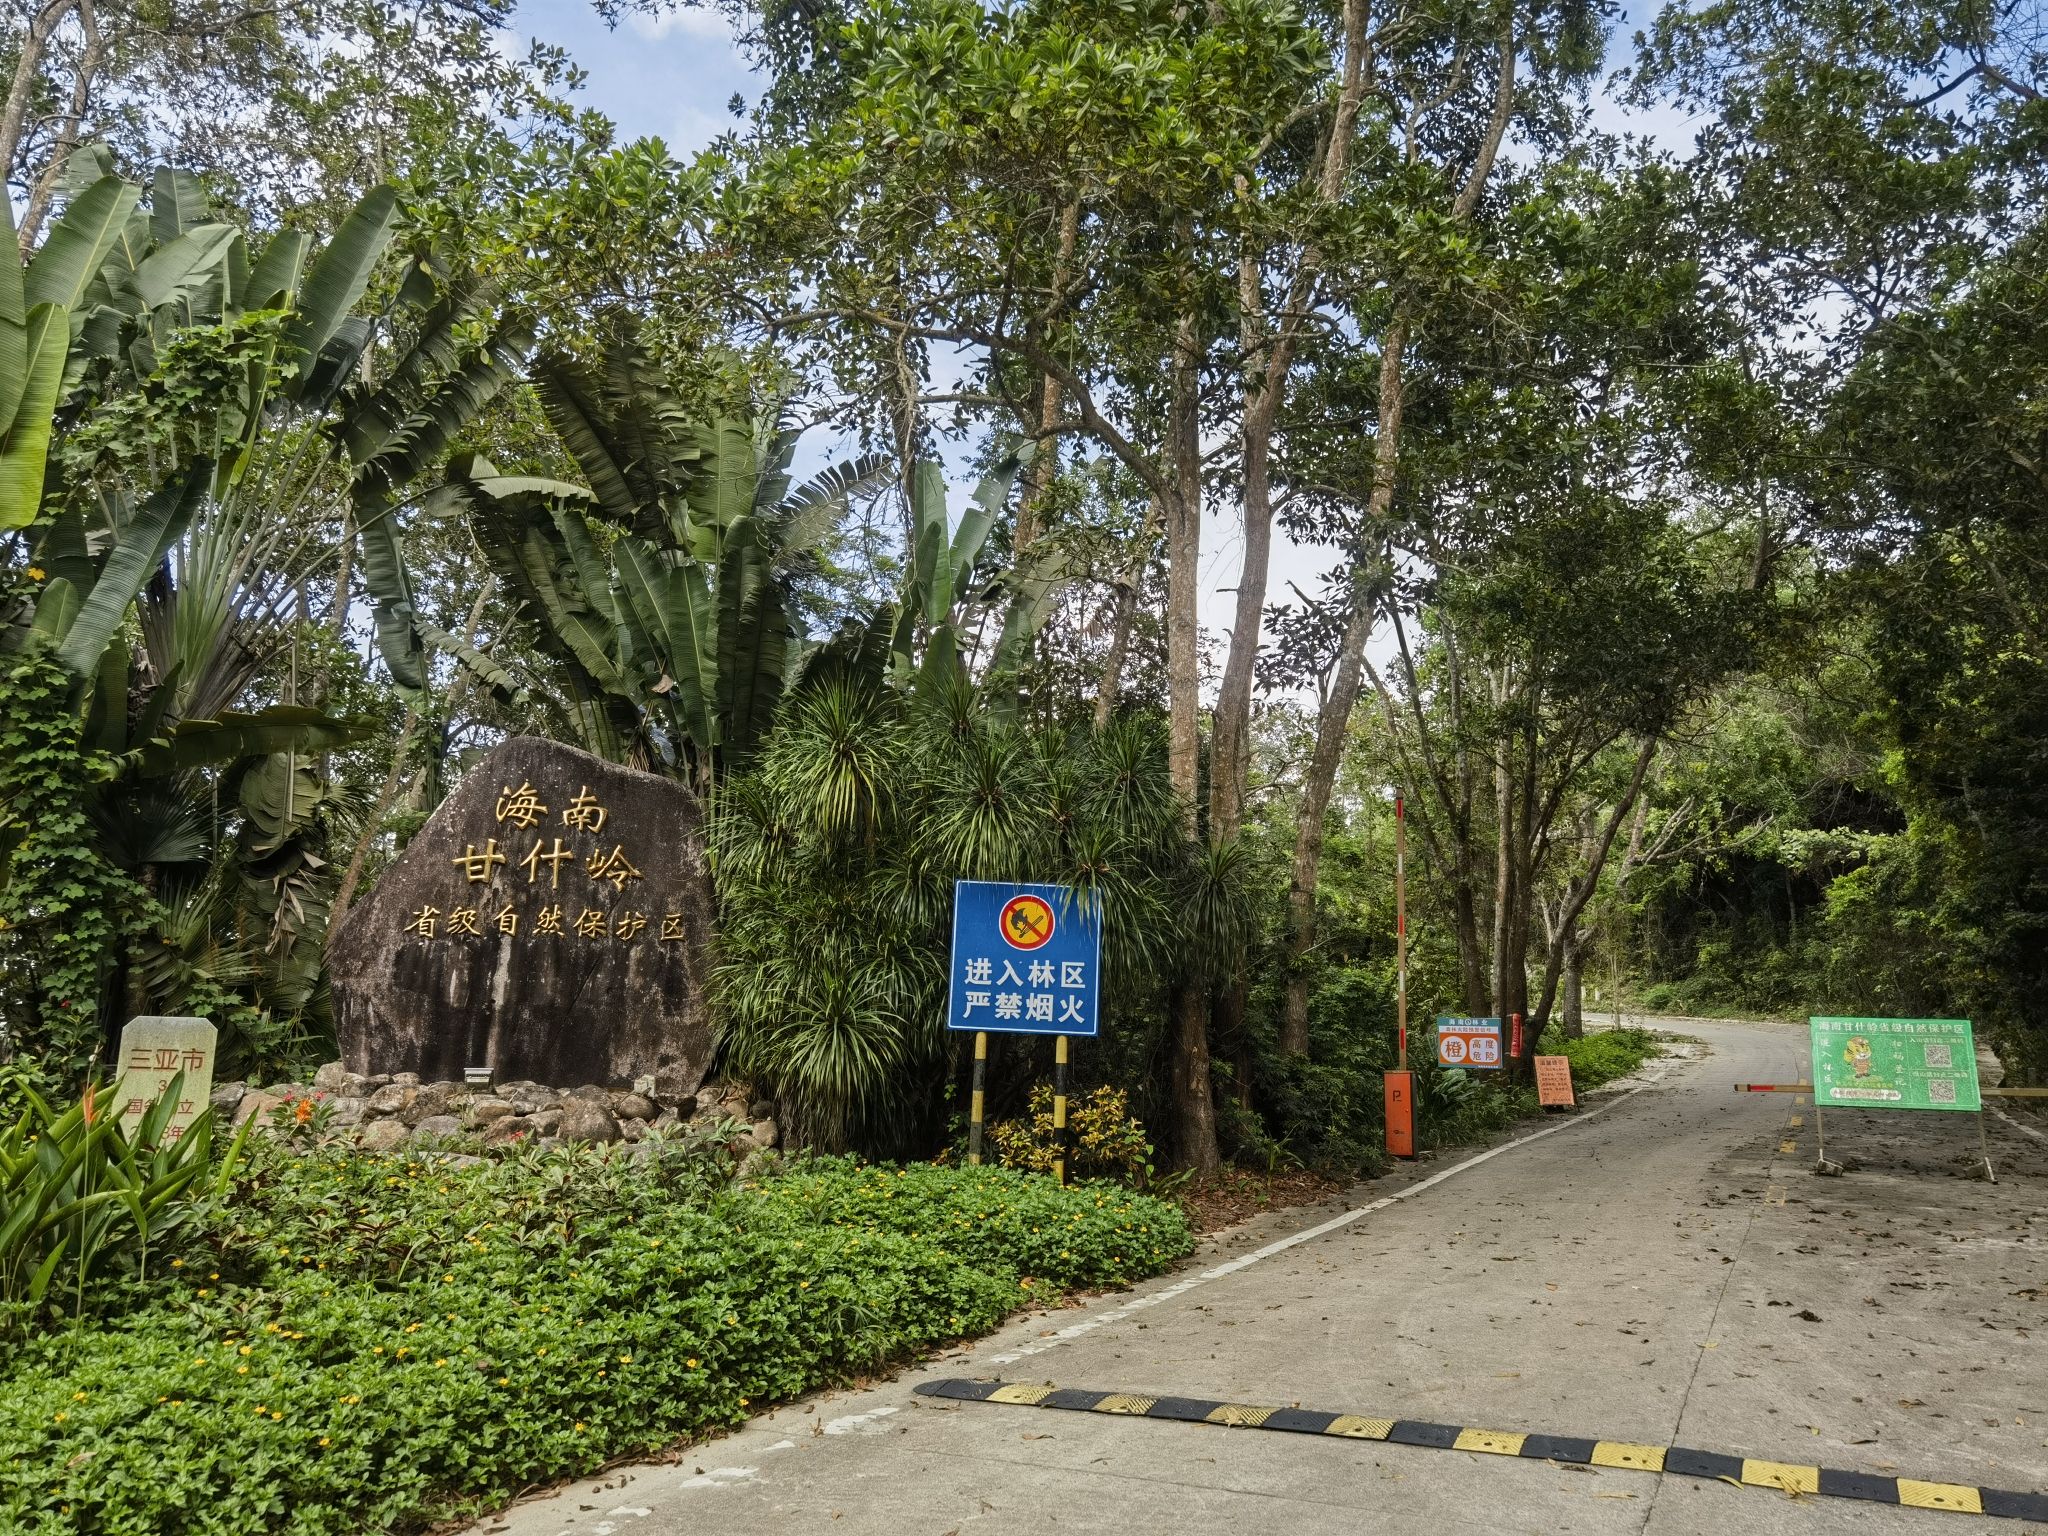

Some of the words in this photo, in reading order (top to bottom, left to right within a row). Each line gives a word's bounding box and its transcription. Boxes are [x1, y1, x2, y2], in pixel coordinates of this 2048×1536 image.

[496, 780, 608, 833] 海南
[452, 838, 644, 892] 甘什岭
[405, 905, 685, 941] 省级自然保护区
[964, 957, 1086, 988] 进入林区
[963, 991, 1085, 1023] 严禁烟火
[1818, 1021, 1965, 1034] 海南甘什岭省级自然保护区
[1445, 1041, 1462, 1058] 橙
[1472, 1039, 1495, 1049] 高度
[1473, 1051, 1495, 1061] 危险
[128, 1048, 206, 1072] 三亚市
[127, 1099, 195, 1114] 国立
